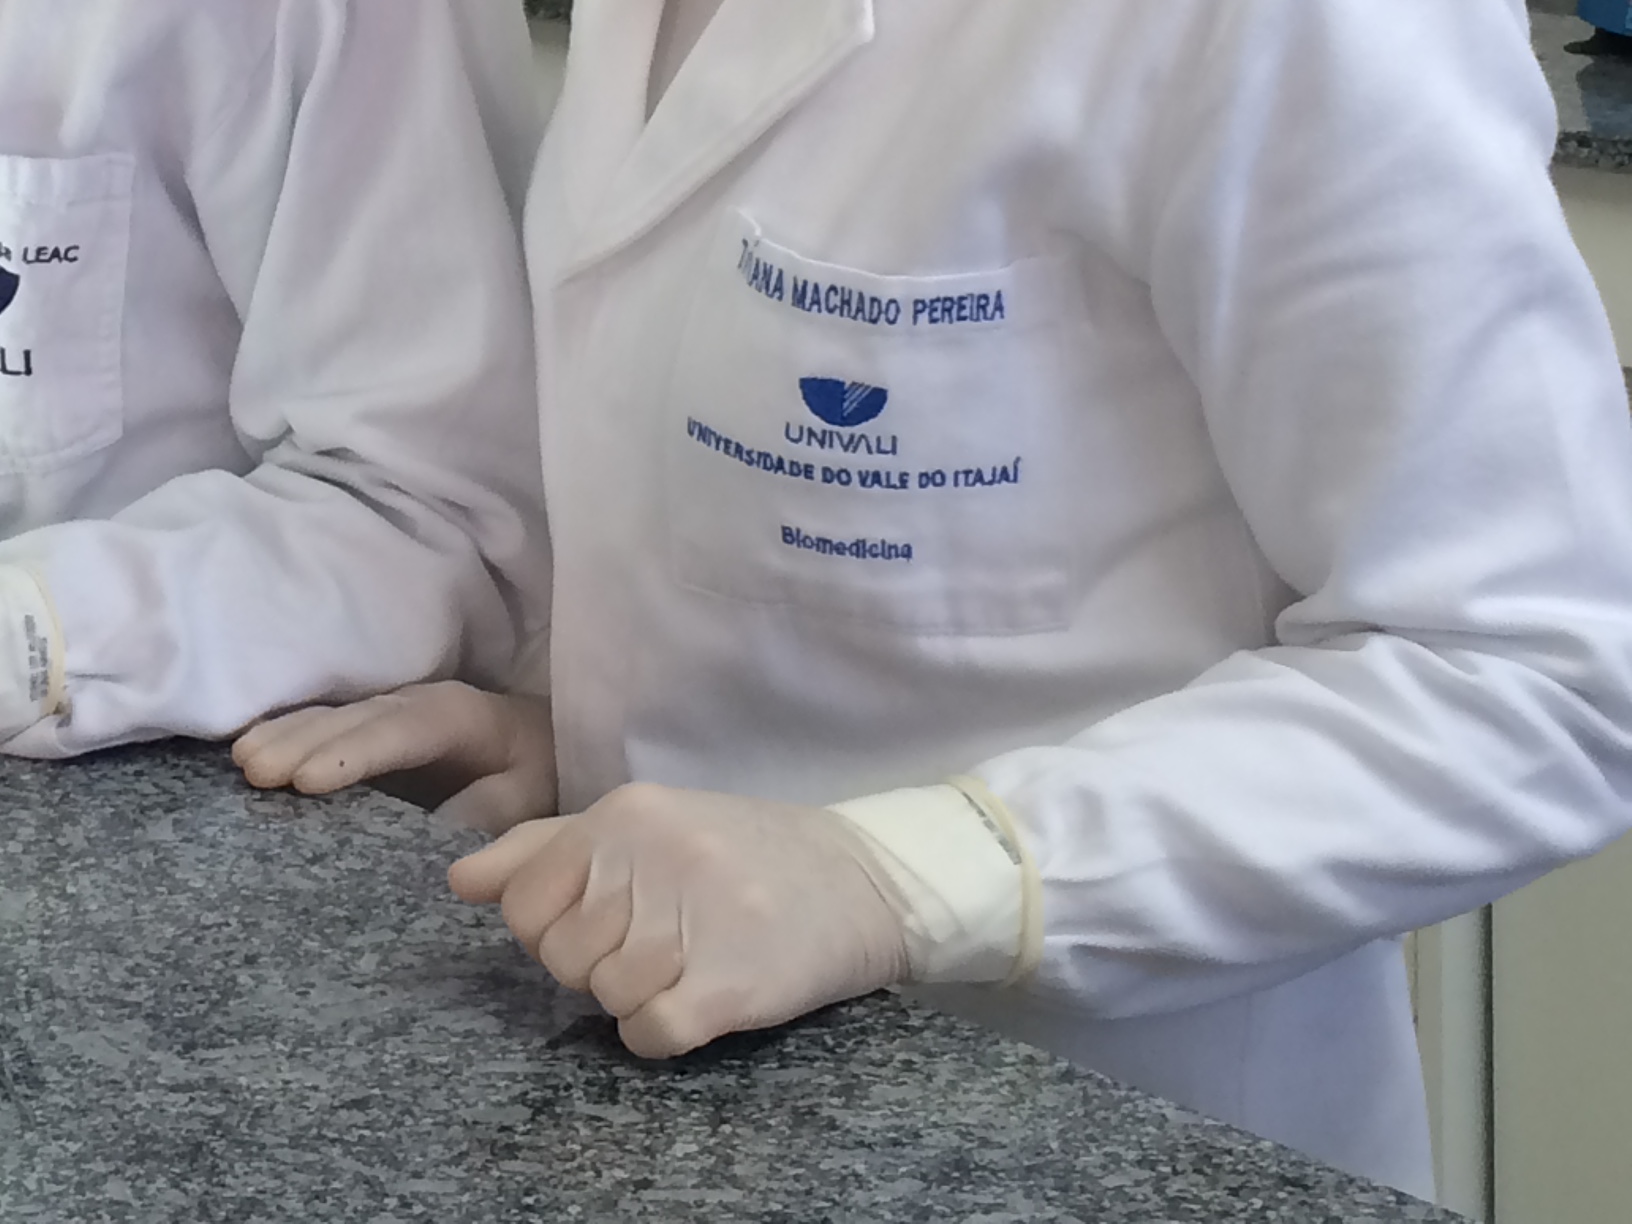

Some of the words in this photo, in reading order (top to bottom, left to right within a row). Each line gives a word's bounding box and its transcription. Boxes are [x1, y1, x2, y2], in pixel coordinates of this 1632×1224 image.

[21, 245, 80, 264] LEAC
[791, 276, 902, 325] MACHADO
[912, 289, 1005, 326] PEREIRA
[686, 416, 815, 481] UNIVERSIDADE
[821, 466, 851, 487] DO
[857, 470, 910, 490] VALE
[917, 469, 947, 489] DO
[952, 456, 1022, 488] ITAJAÍ
[784, 421, 898, 456] UNIVALI
[780, 525, 914, 562] Biomedicina
